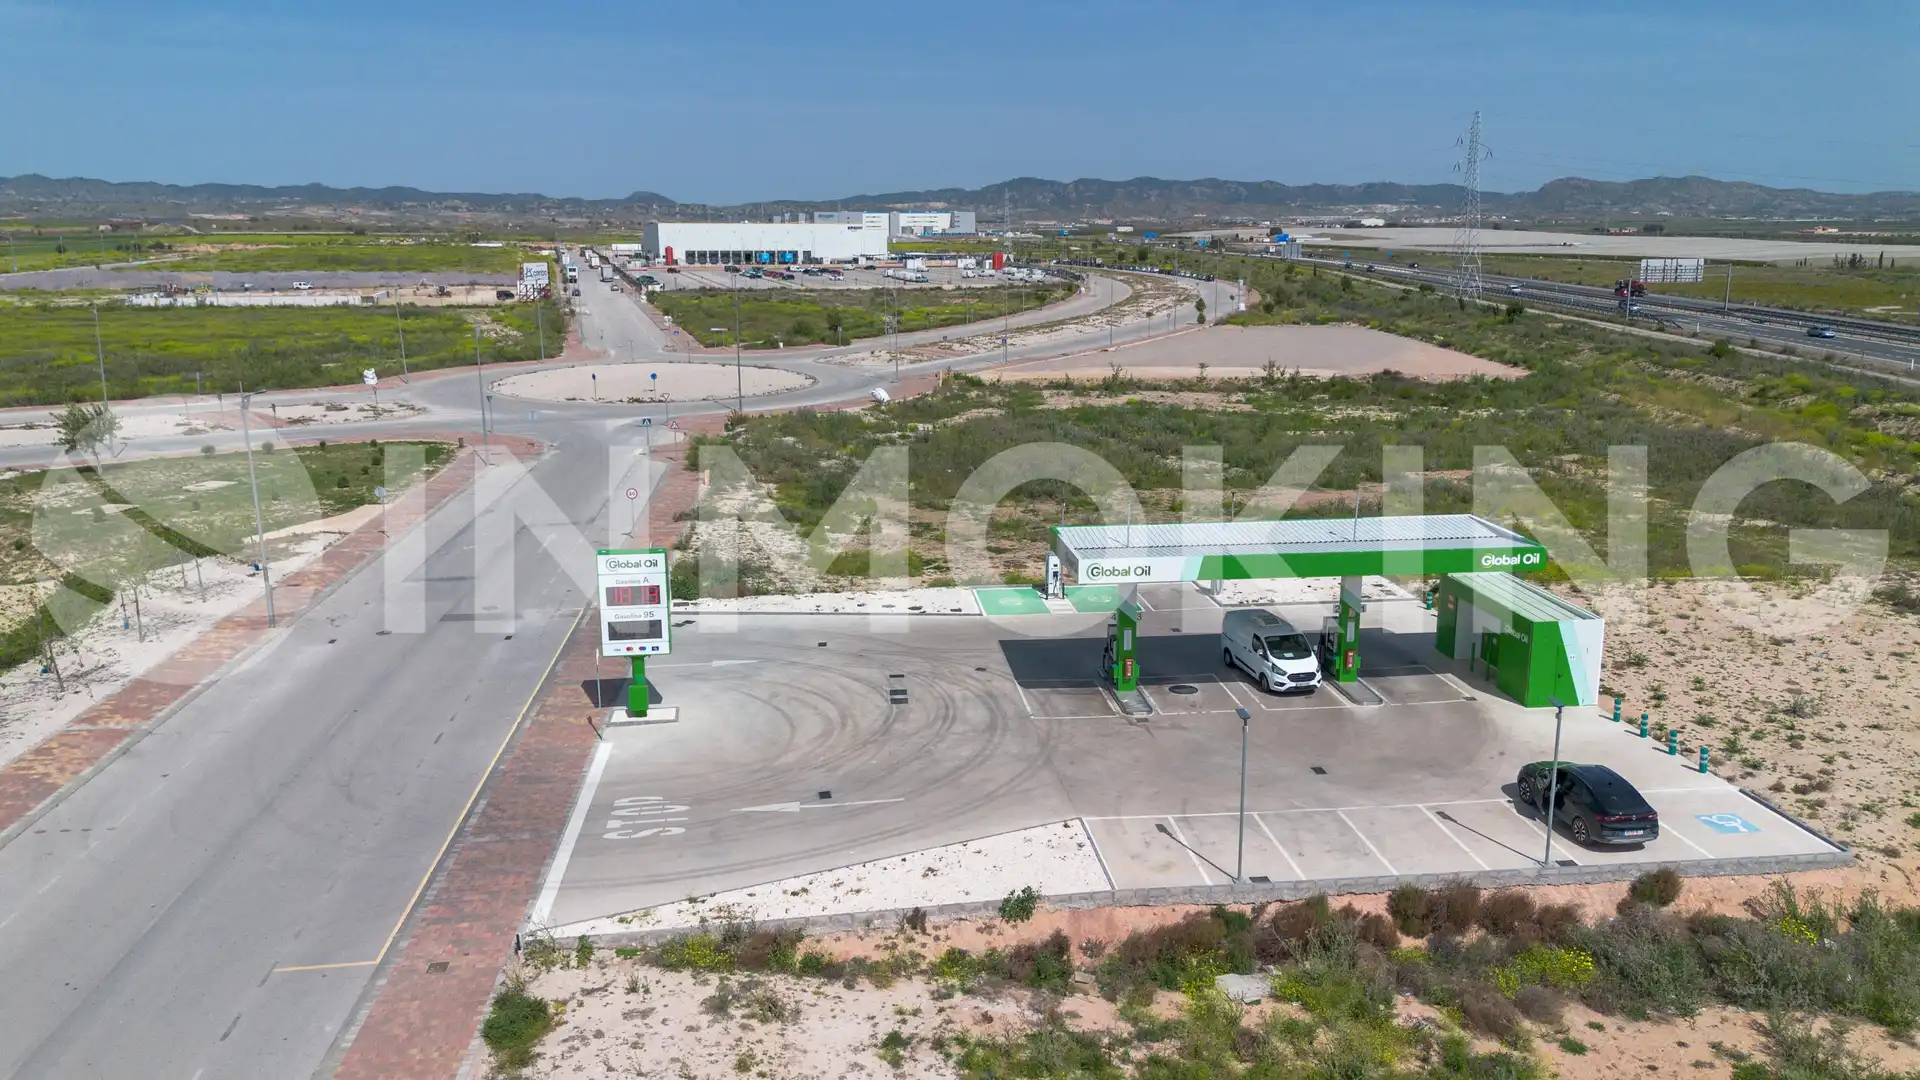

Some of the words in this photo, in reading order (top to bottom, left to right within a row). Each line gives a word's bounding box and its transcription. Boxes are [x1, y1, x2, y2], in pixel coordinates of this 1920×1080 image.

[608, 559, 642, 570] Global
[644, 559, 658, 568] Oil
[1481, 553, 1521, 567] Global
[1522, 552, 1540, 565] Oil
[1089, 565, 1131, 577] Global
[1134, 565, 1151, 577] Oil
[643, 576, 649, 584] A
[1335, 604, 1341, 613] 2
[1137, 613, 1142, 621] 3
[602, 796, 691, 840] STOP
